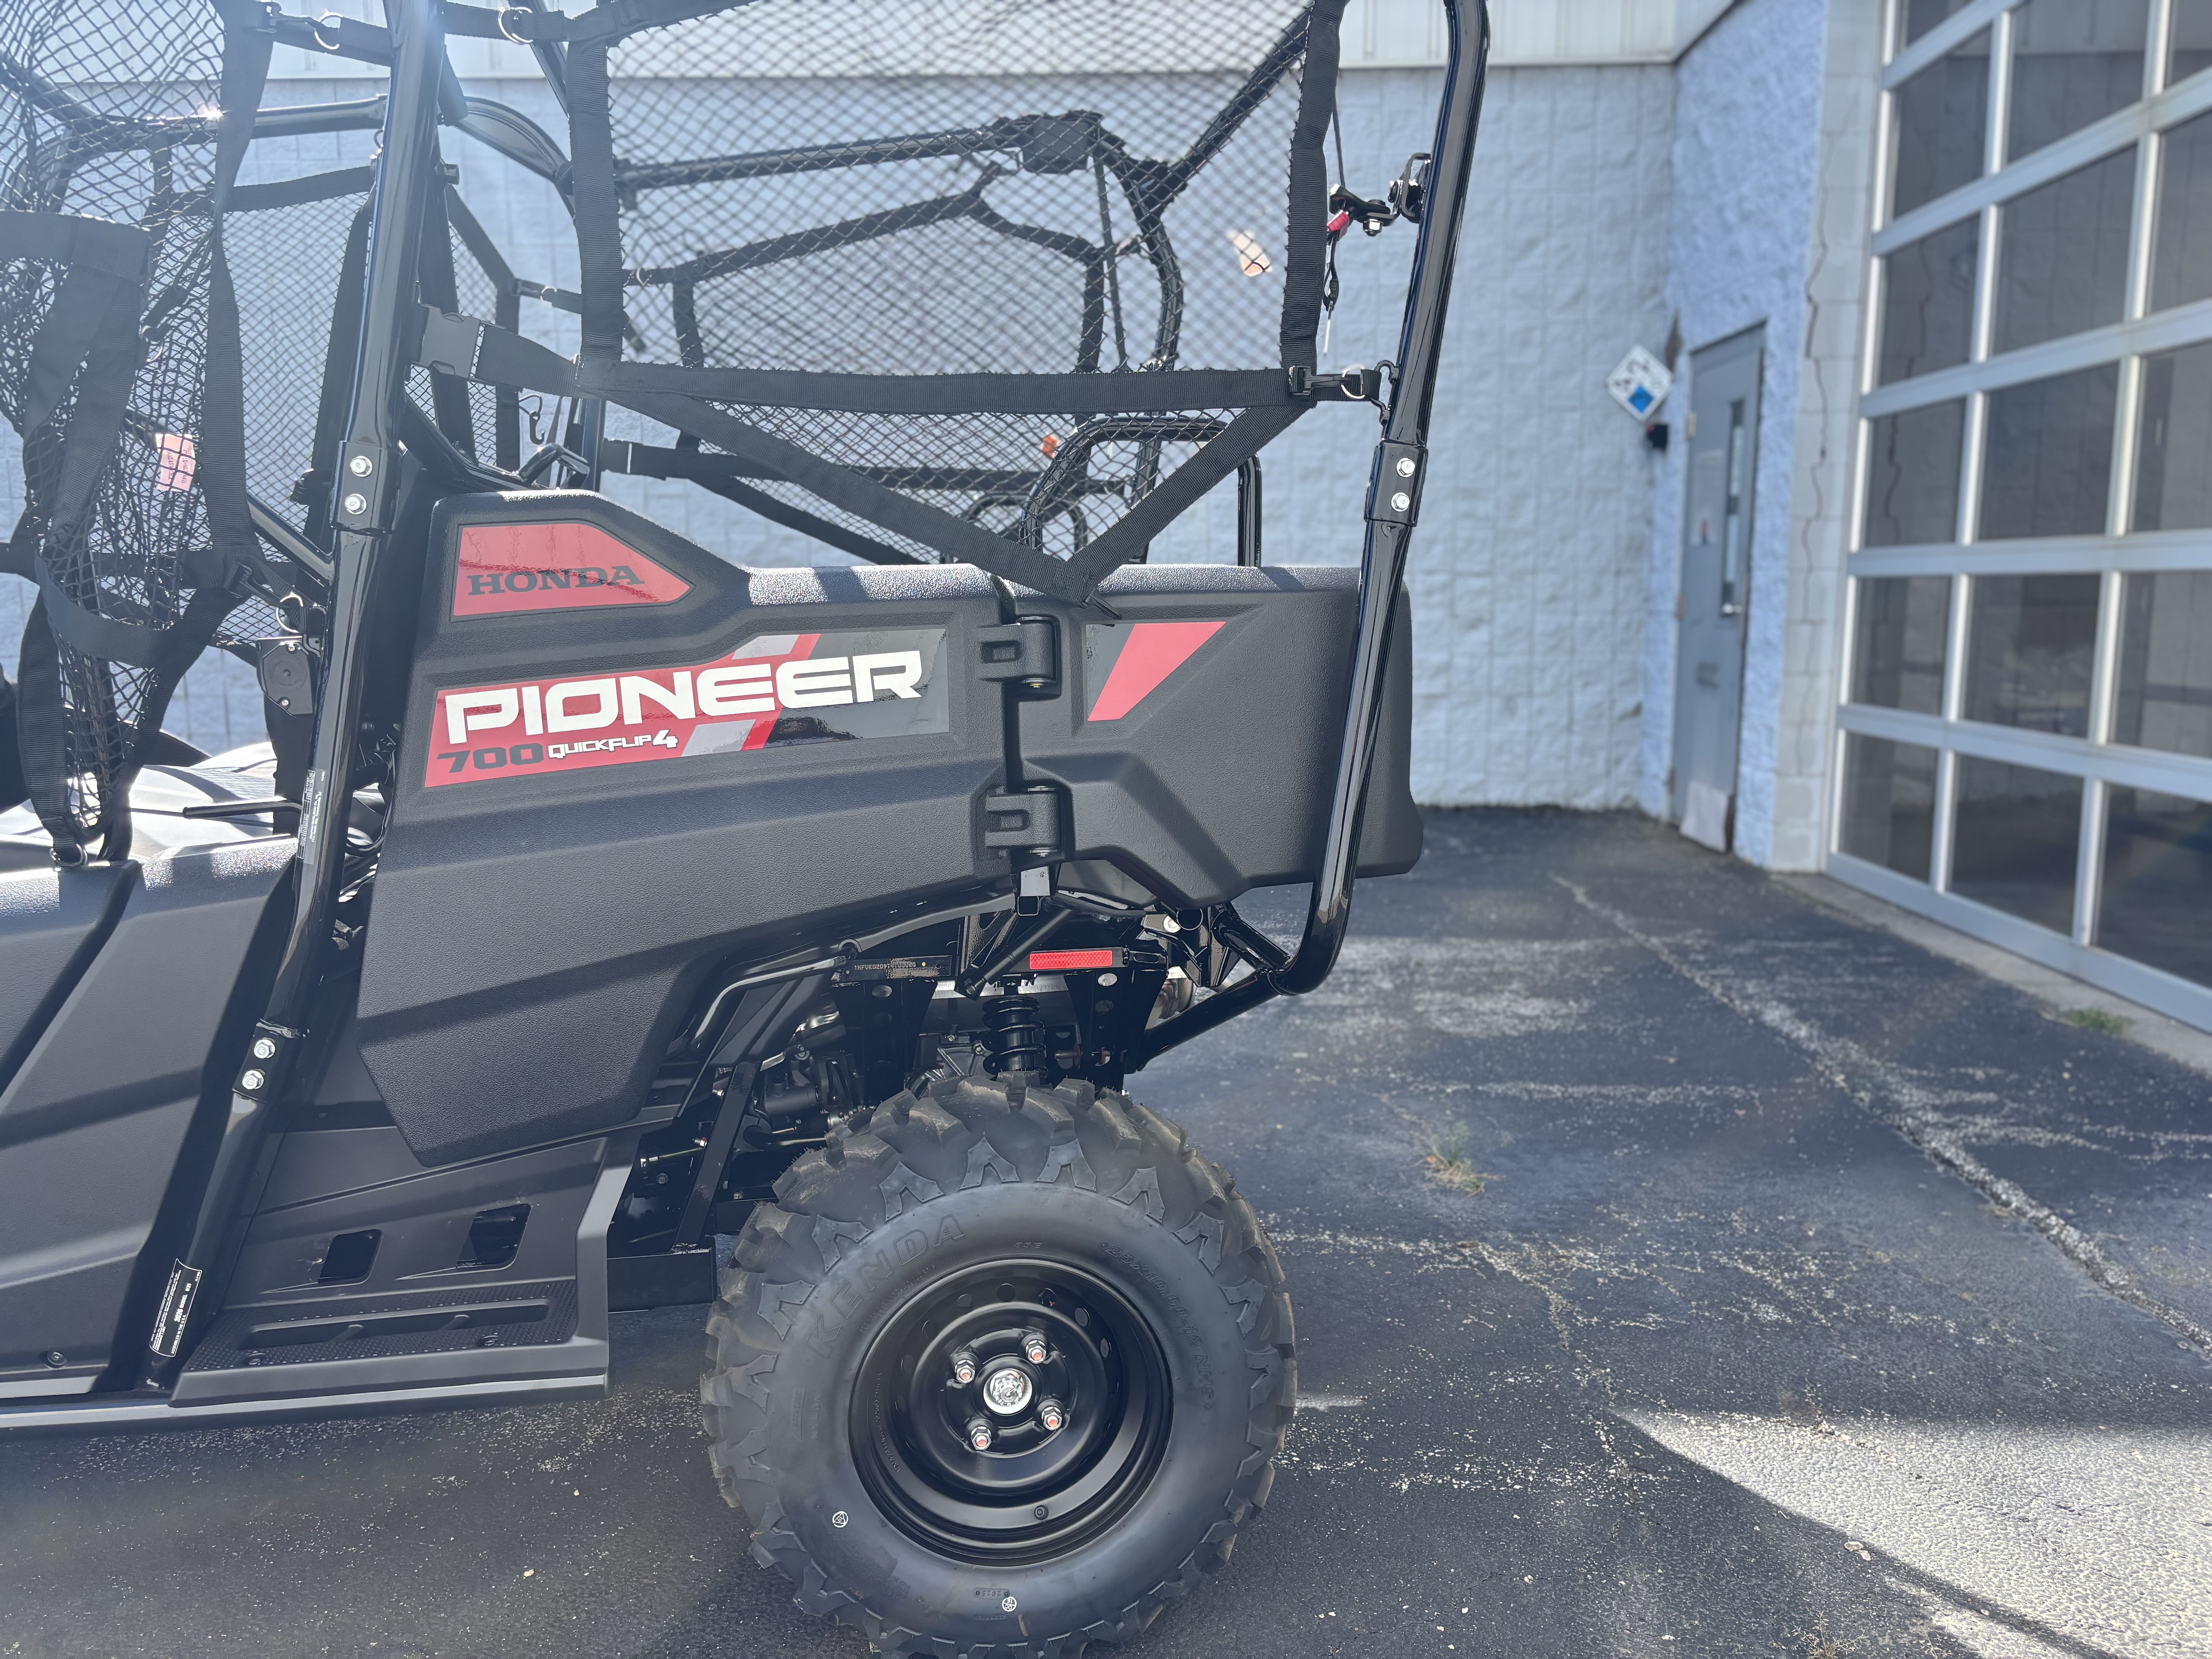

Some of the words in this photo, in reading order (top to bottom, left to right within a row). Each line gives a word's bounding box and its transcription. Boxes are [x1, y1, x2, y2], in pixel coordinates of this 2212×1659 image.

[467, 565, 644, 596] HONDA
[445, 650, 922, 744] PIONEER
[437, 742, 543, 773] 700
[805, 1214, 967, 1359] KENDA
[174, 1309, 184, 1322] 2026
[179, 1294, 188, 1309] MODEL
[1194, 1353, 1215, 1400] NHS
